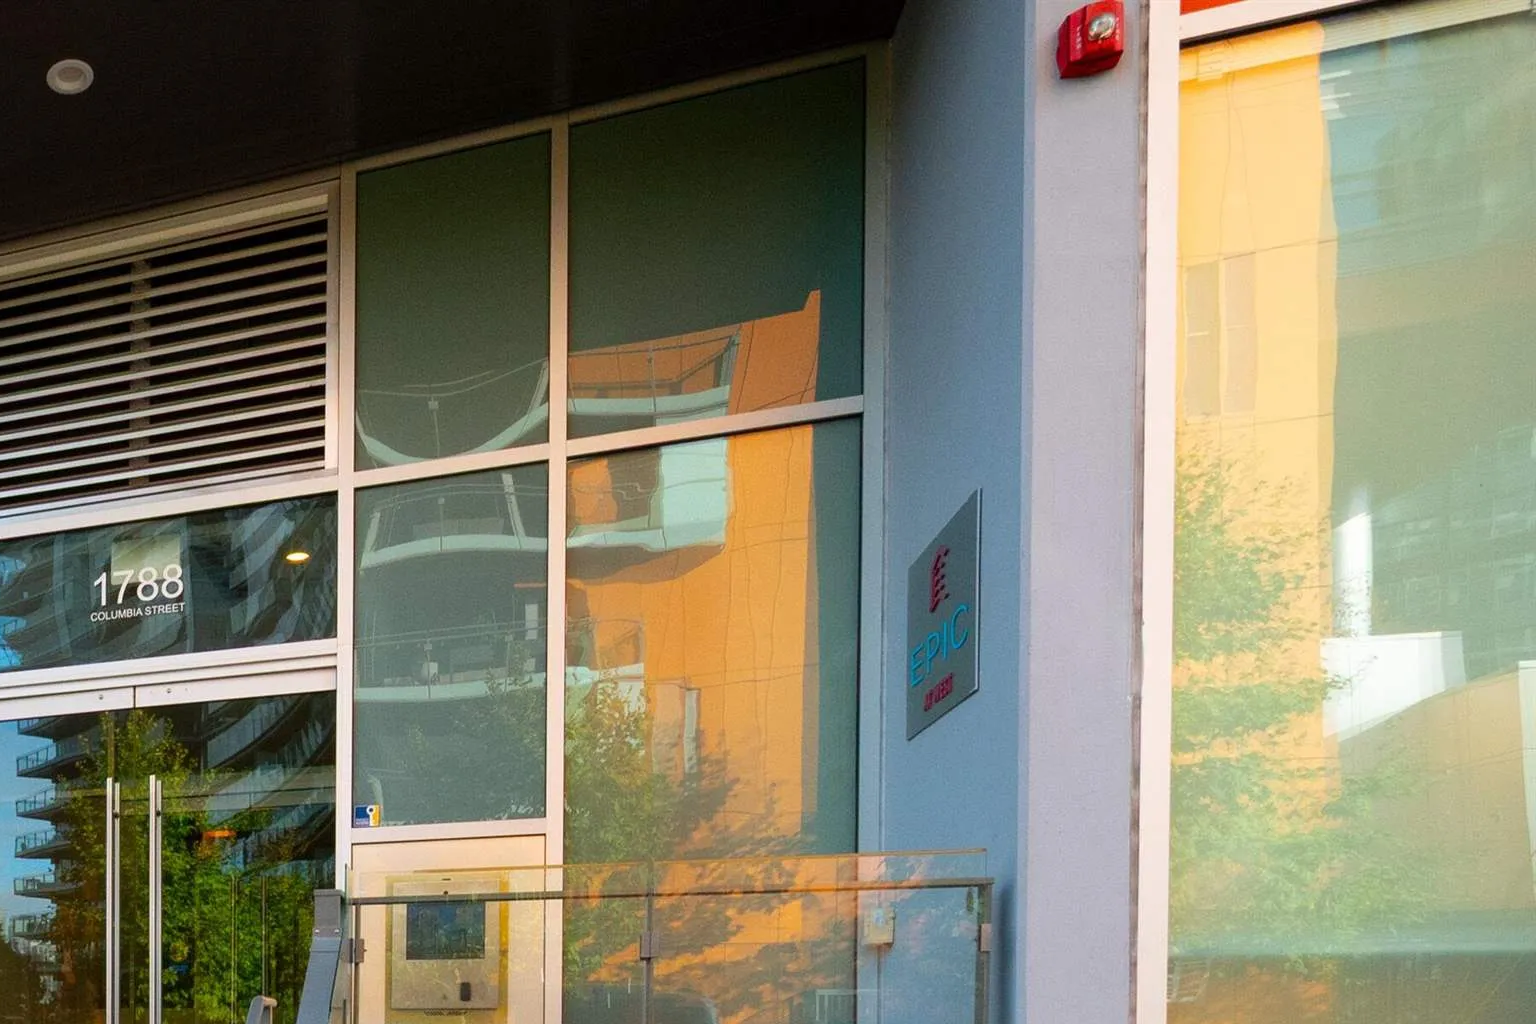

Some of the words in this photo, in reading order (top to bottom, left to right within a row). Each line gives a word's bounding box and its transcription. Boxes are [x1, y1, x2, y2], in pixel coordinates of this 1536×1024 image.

[94, 564, 184, 606] 1788
[90, 608, 144, 622] COLUMBIA
[144, 602, 185, 616] STREET
[911, 604, 969, 688] EPIC
